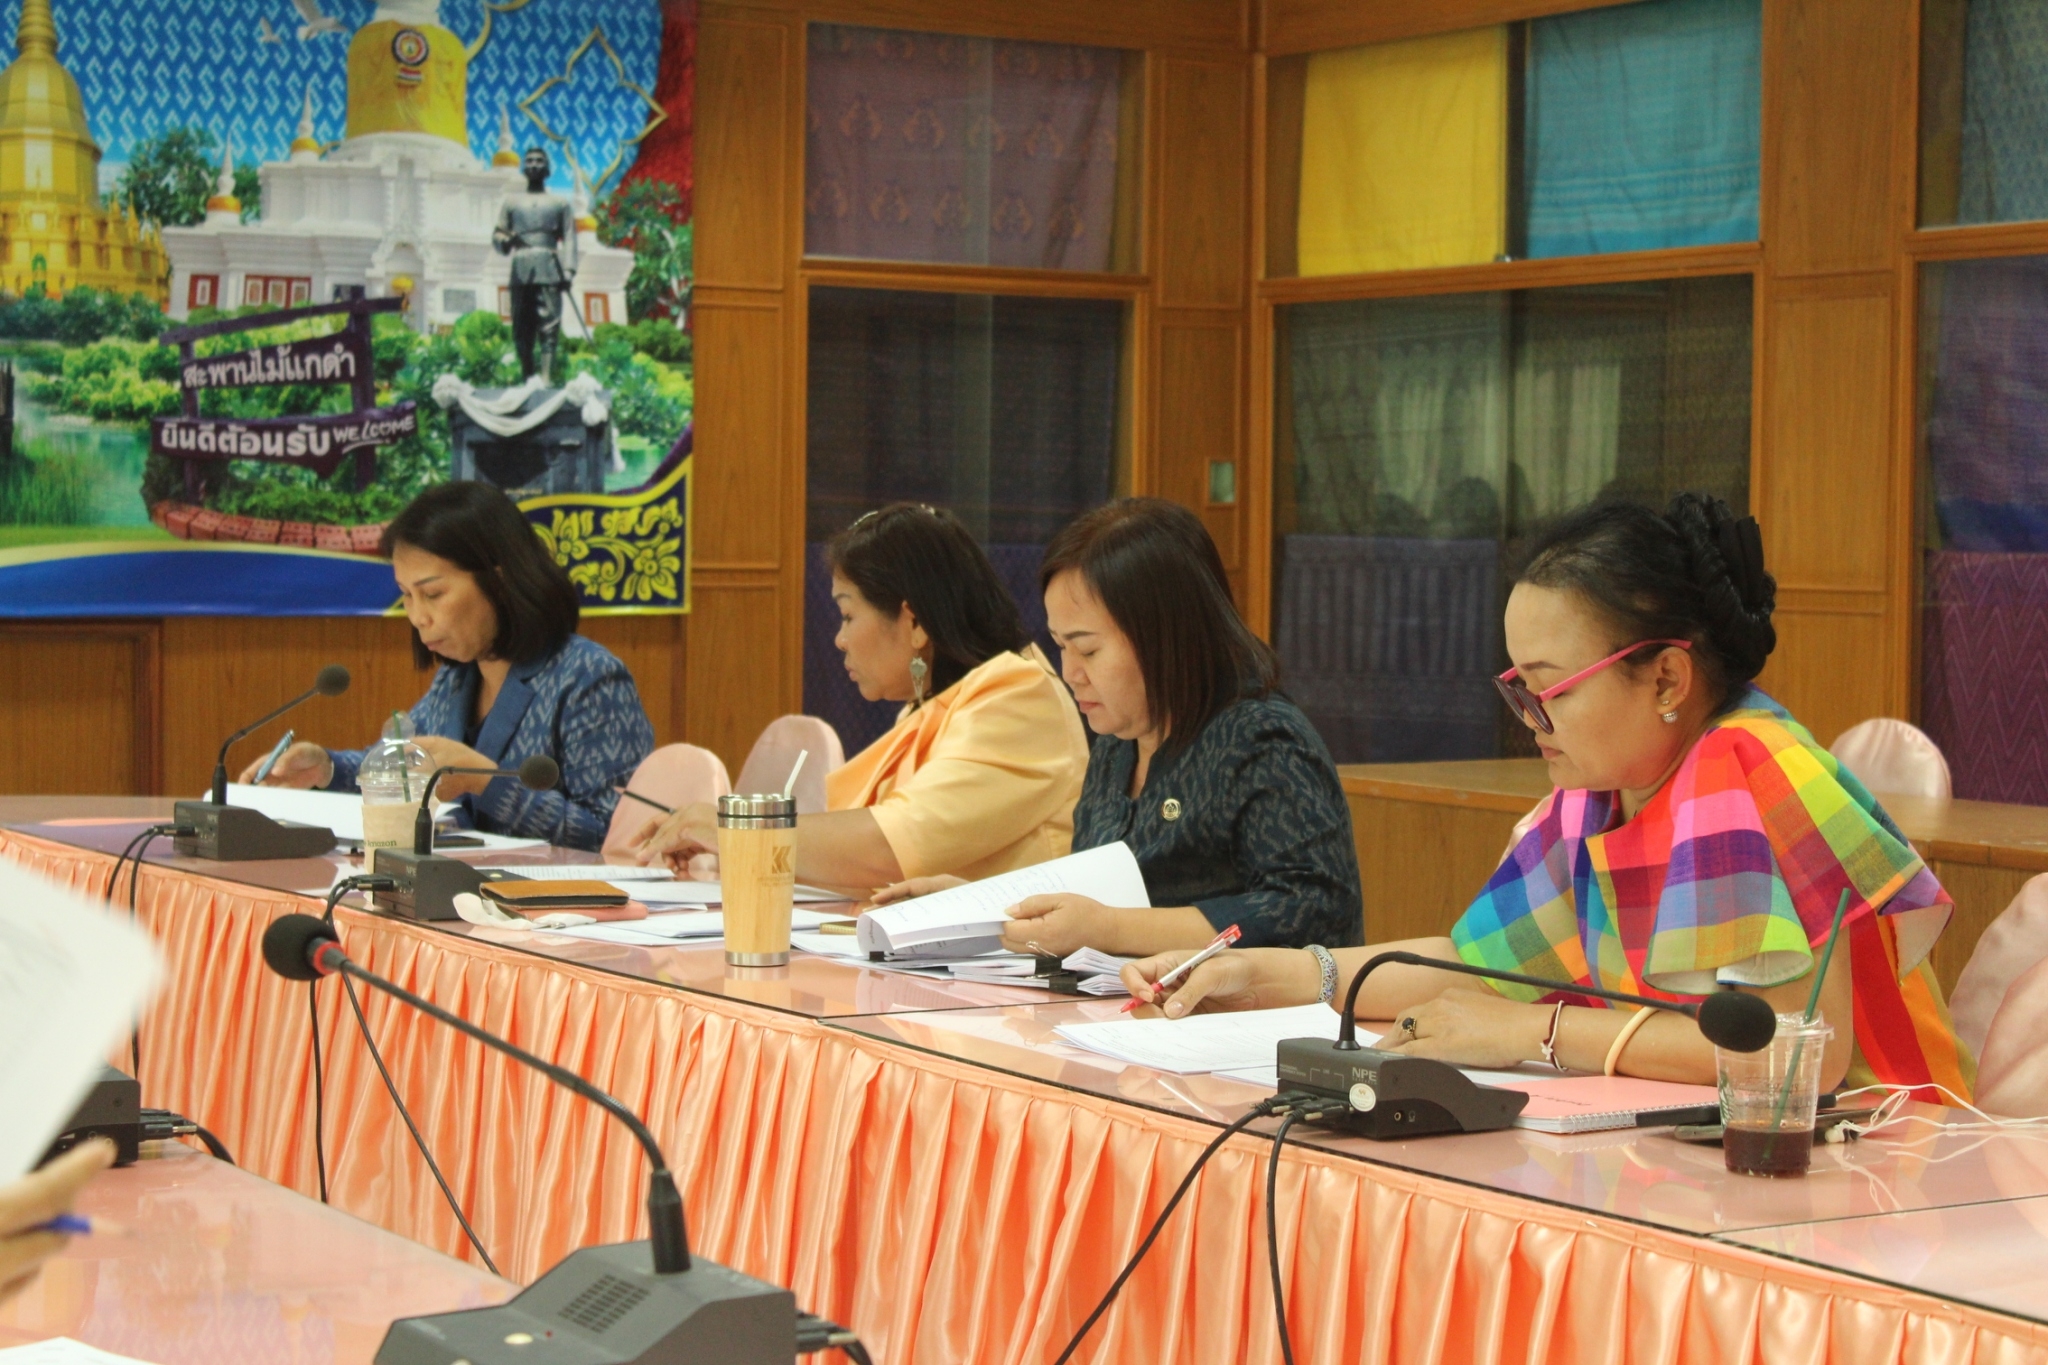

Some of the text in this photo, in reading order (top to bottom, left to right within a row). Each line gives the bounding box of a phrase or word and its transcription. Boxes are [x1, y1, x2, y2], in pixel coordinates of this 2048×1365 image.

[183, 342, 356, 389] สะพานไม้แกดำ
[161, 422, 331, 457] ยินดีต้อนรับ
[1351, 1066, 1378, 1082] NPE
